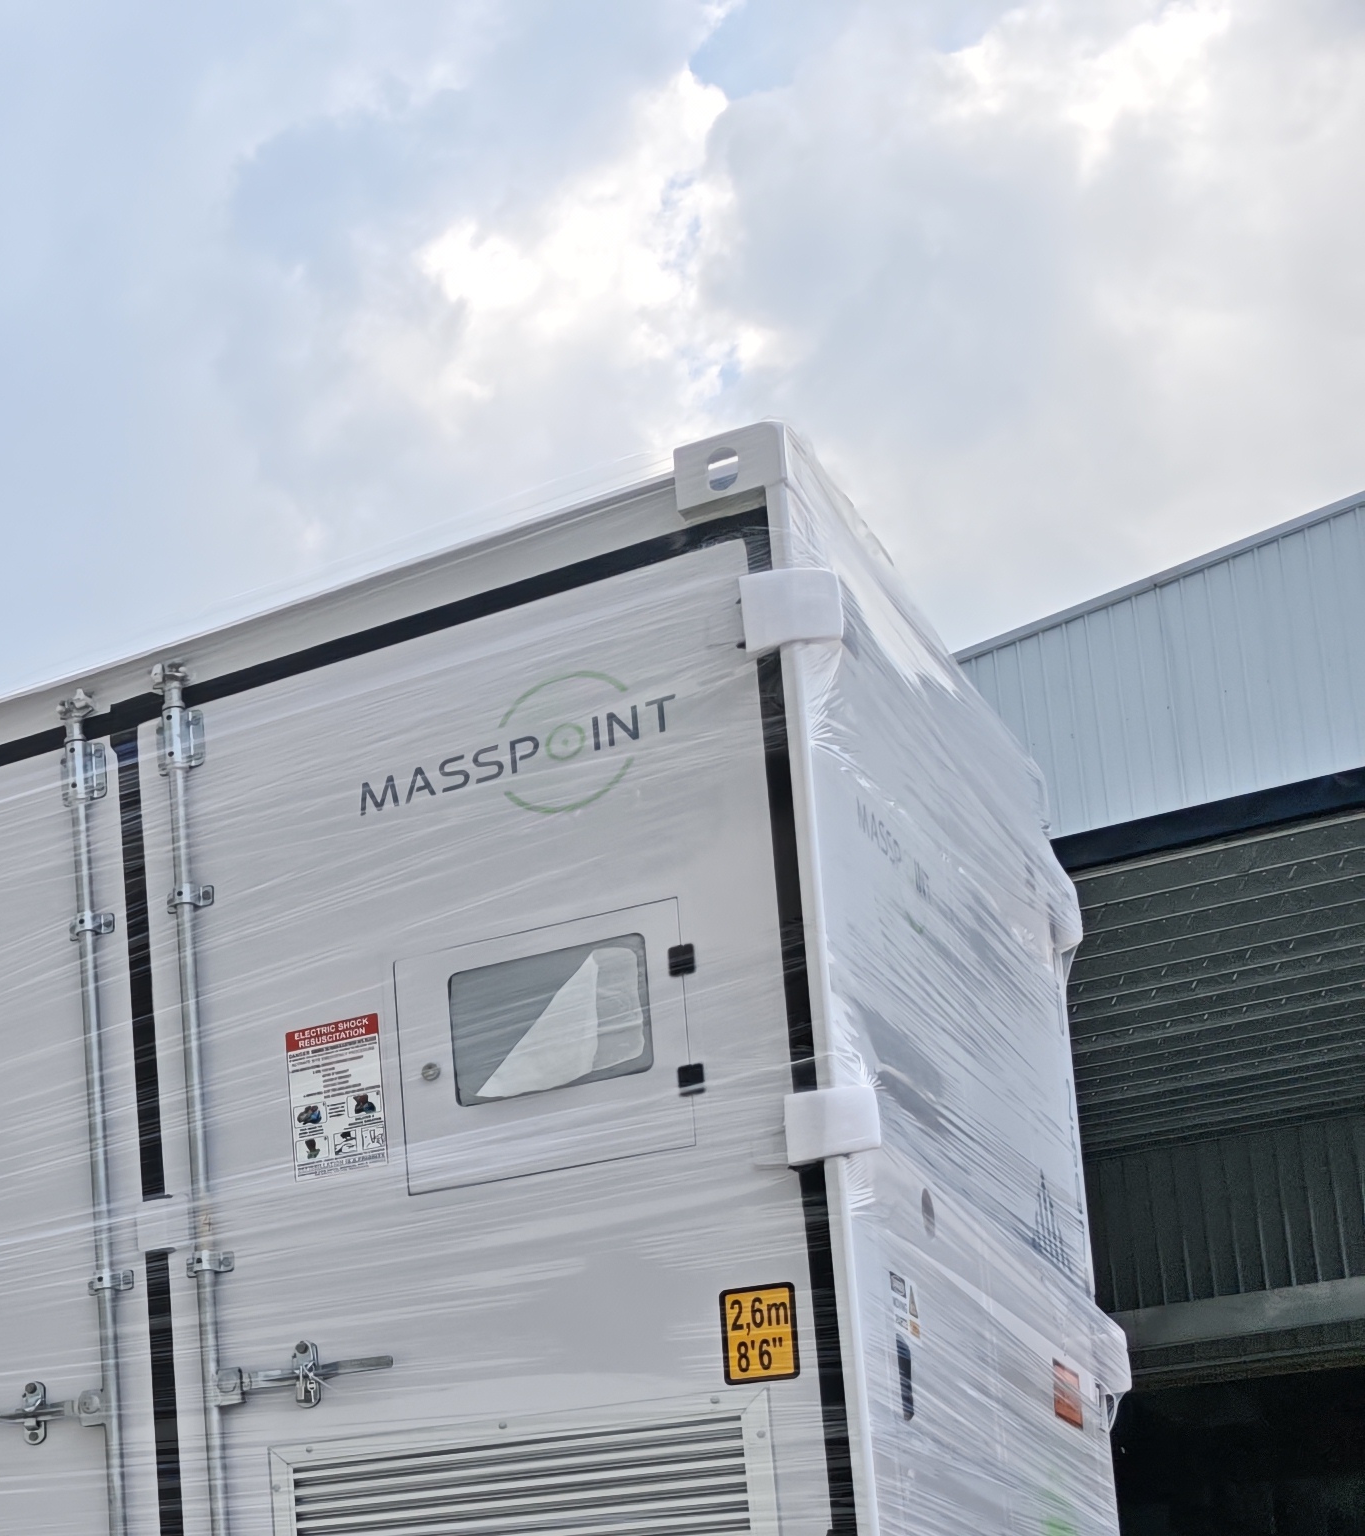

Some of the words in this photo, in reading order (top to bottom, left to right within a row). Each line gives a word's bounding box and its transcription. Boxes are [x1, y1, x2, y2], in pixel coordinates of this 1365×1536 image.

[360, 694, 676, 816] MASSPOINT
[294, 1024, 336, 1040] ELECTRIC
[338, 1017, 369, 1031] SHOCK
[298, 1027, 366, 1048] RESUSCITATION
[729, 1297, 789, 1336] 2,6m
[737, 1336, 783, 1373] 8'6"
